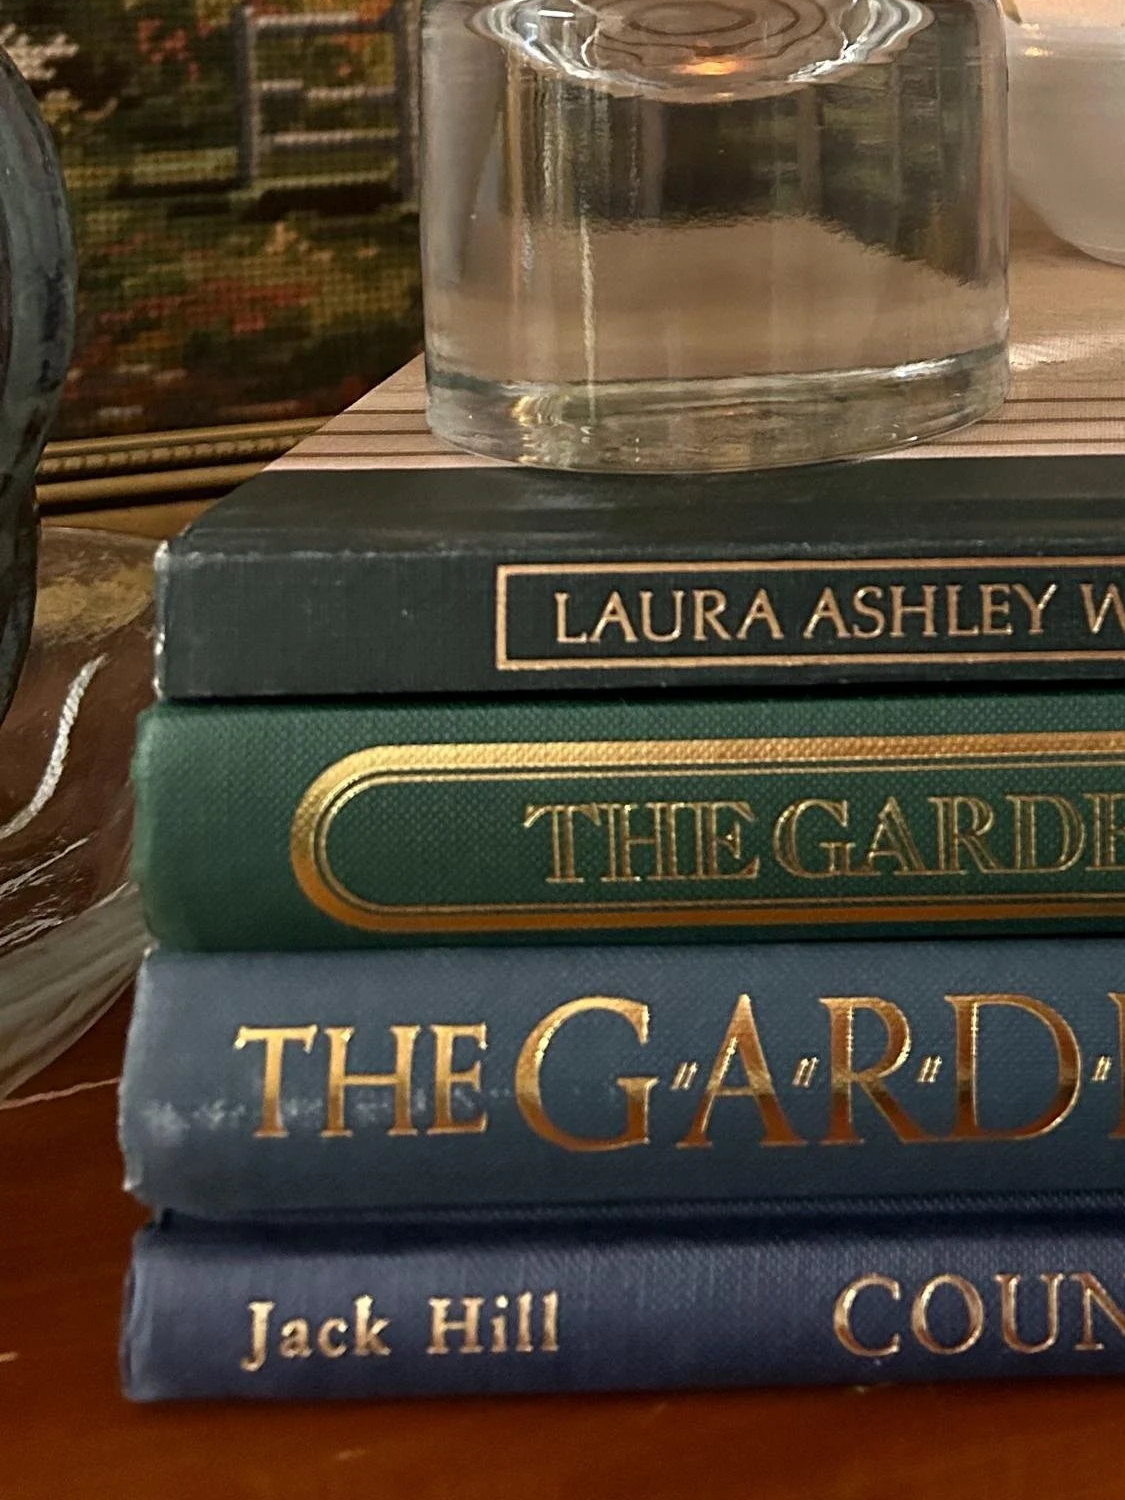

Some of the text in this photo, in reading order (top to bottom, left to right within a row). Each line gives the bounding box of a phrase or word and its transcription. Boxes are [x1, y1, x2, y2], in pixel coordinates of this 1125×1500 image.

[555, 589, 787, 645] LAURA
[803, 583, 1058, 641] ASHLEY
[524, 799, 763, 884] THE
[234, 1021, 490, 1139] THE
[240, 1291, 560, 1373] Jack Hill
